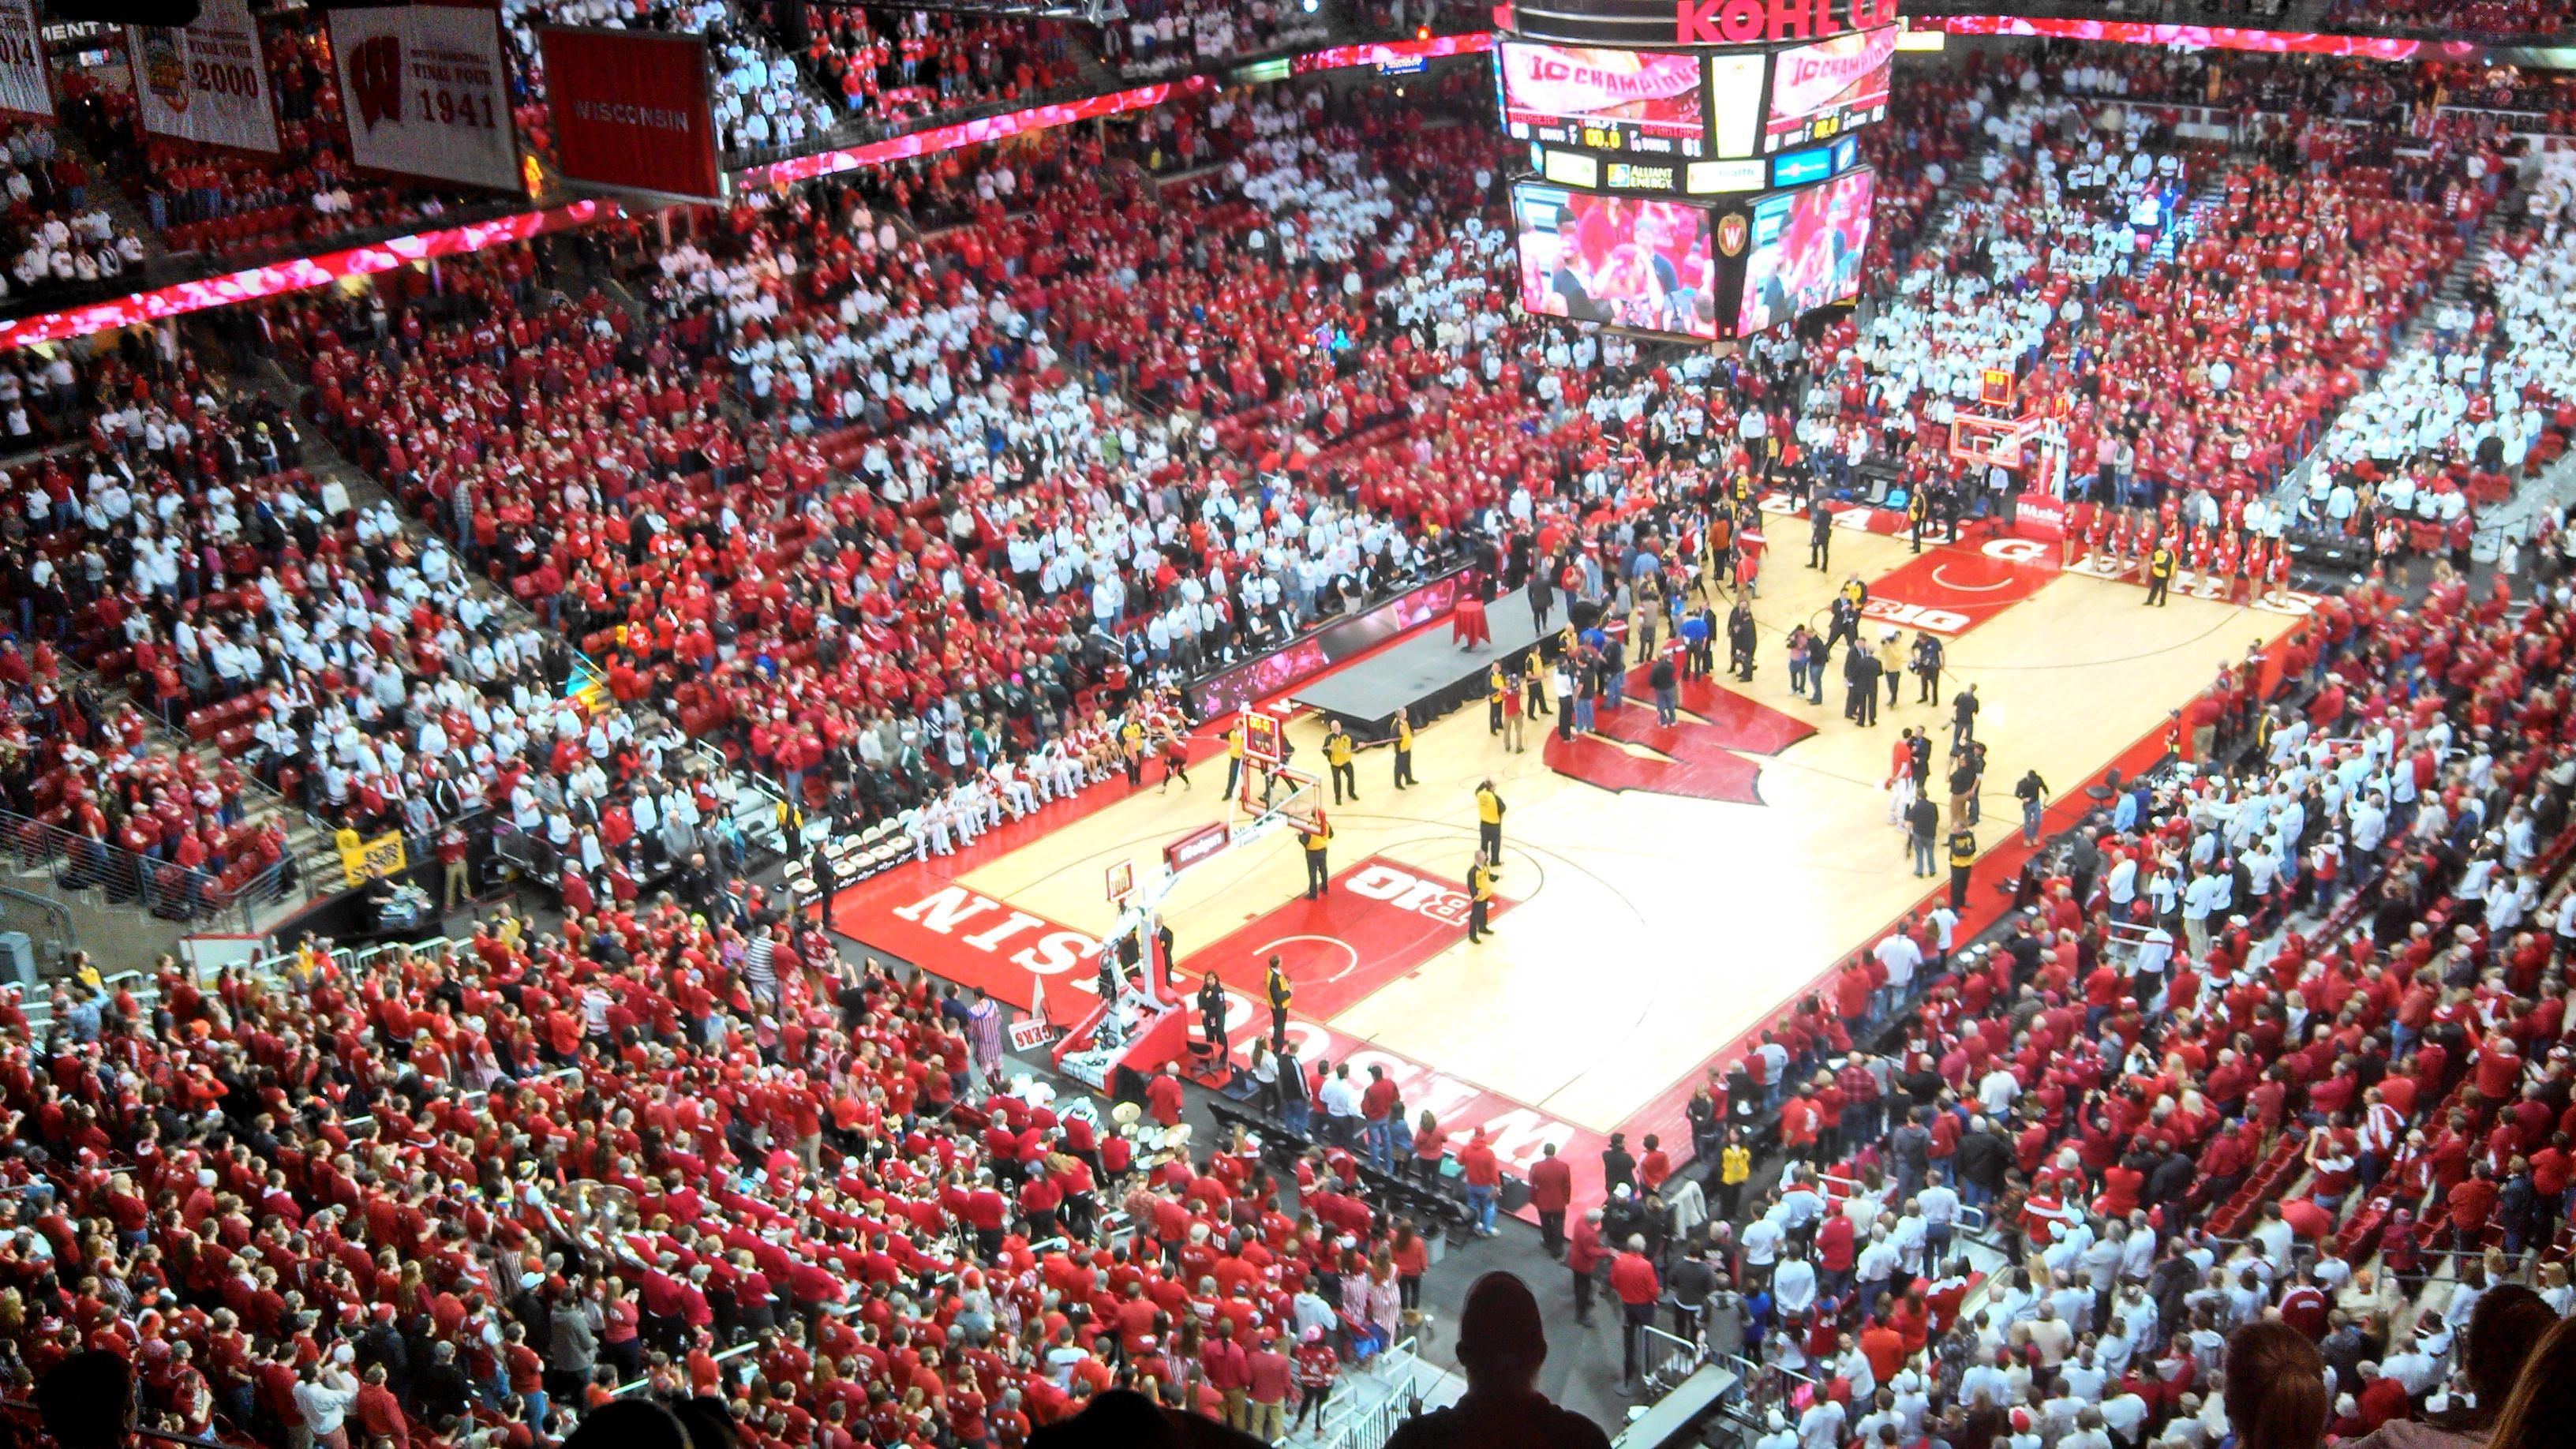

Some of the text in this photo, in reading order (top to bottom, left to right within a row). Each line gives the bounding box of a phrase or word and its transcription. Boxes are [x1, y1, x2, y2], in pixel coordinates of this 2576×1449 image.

[1676, 0, 1840, 44] KOHL
[193, 61, 259, 99] 2000
[420, 88, 496, 129] 1941
[574, 100, 691, 133] WISCONSIN
[1631, 165, 1673, 178] ALLIANT
[1631, 176, 1672, 189] ENERGY
[1724, 227, 1741, 249] W
